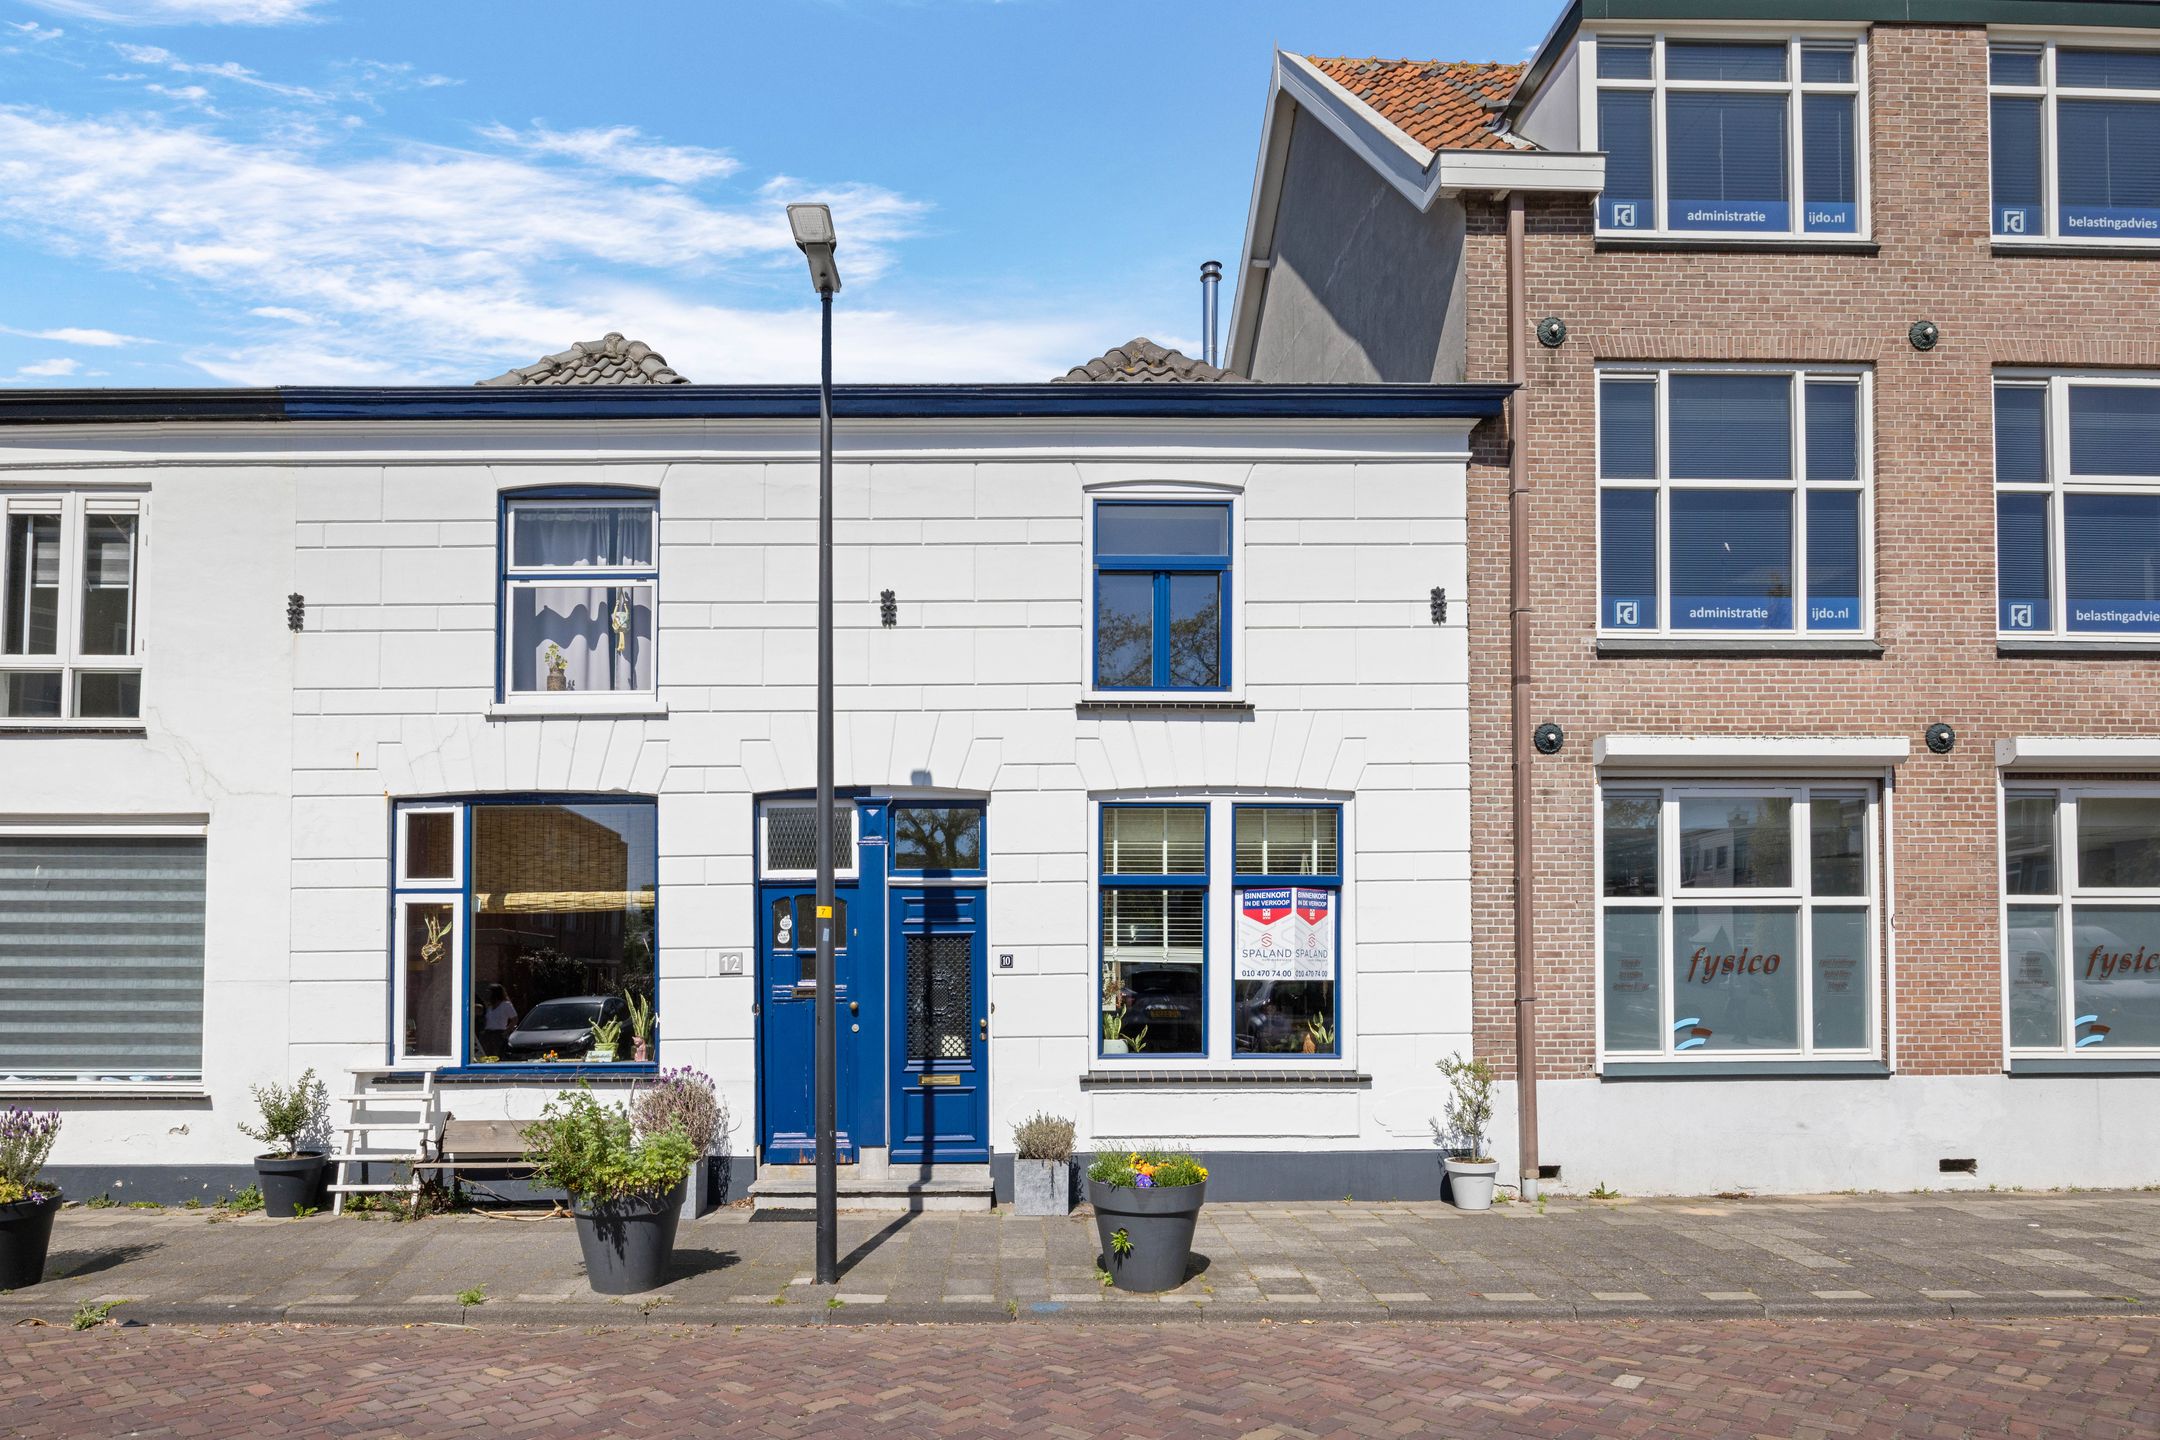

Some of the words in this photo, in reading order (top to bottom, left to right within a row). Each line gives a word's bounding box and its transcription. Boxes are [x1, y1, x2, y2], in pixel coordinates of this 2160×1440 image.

[1687, 210, 1766, 223] administratie
[1808, 211, 1846, 224] ijdo.nl
[2069, 216, 2158, 230] belastingadvies
[1689, 607, 1769, 619] administratie
[1811, 607, 1849, 620] ijdo.nl
[1245, 891, 1290, 899] BINNENKORT
[821, 907, 826, 915] 7
[1242, 949, 1292, 958] SPALAND
[1295, 949, 1328, 958] SPALAND
[721, 955, 740, 971] 12
[1002, 956, 1011, 966] 10
[1688, 947, 1780, 984] fysico
[2086, 945, 2160, 980] fysic
